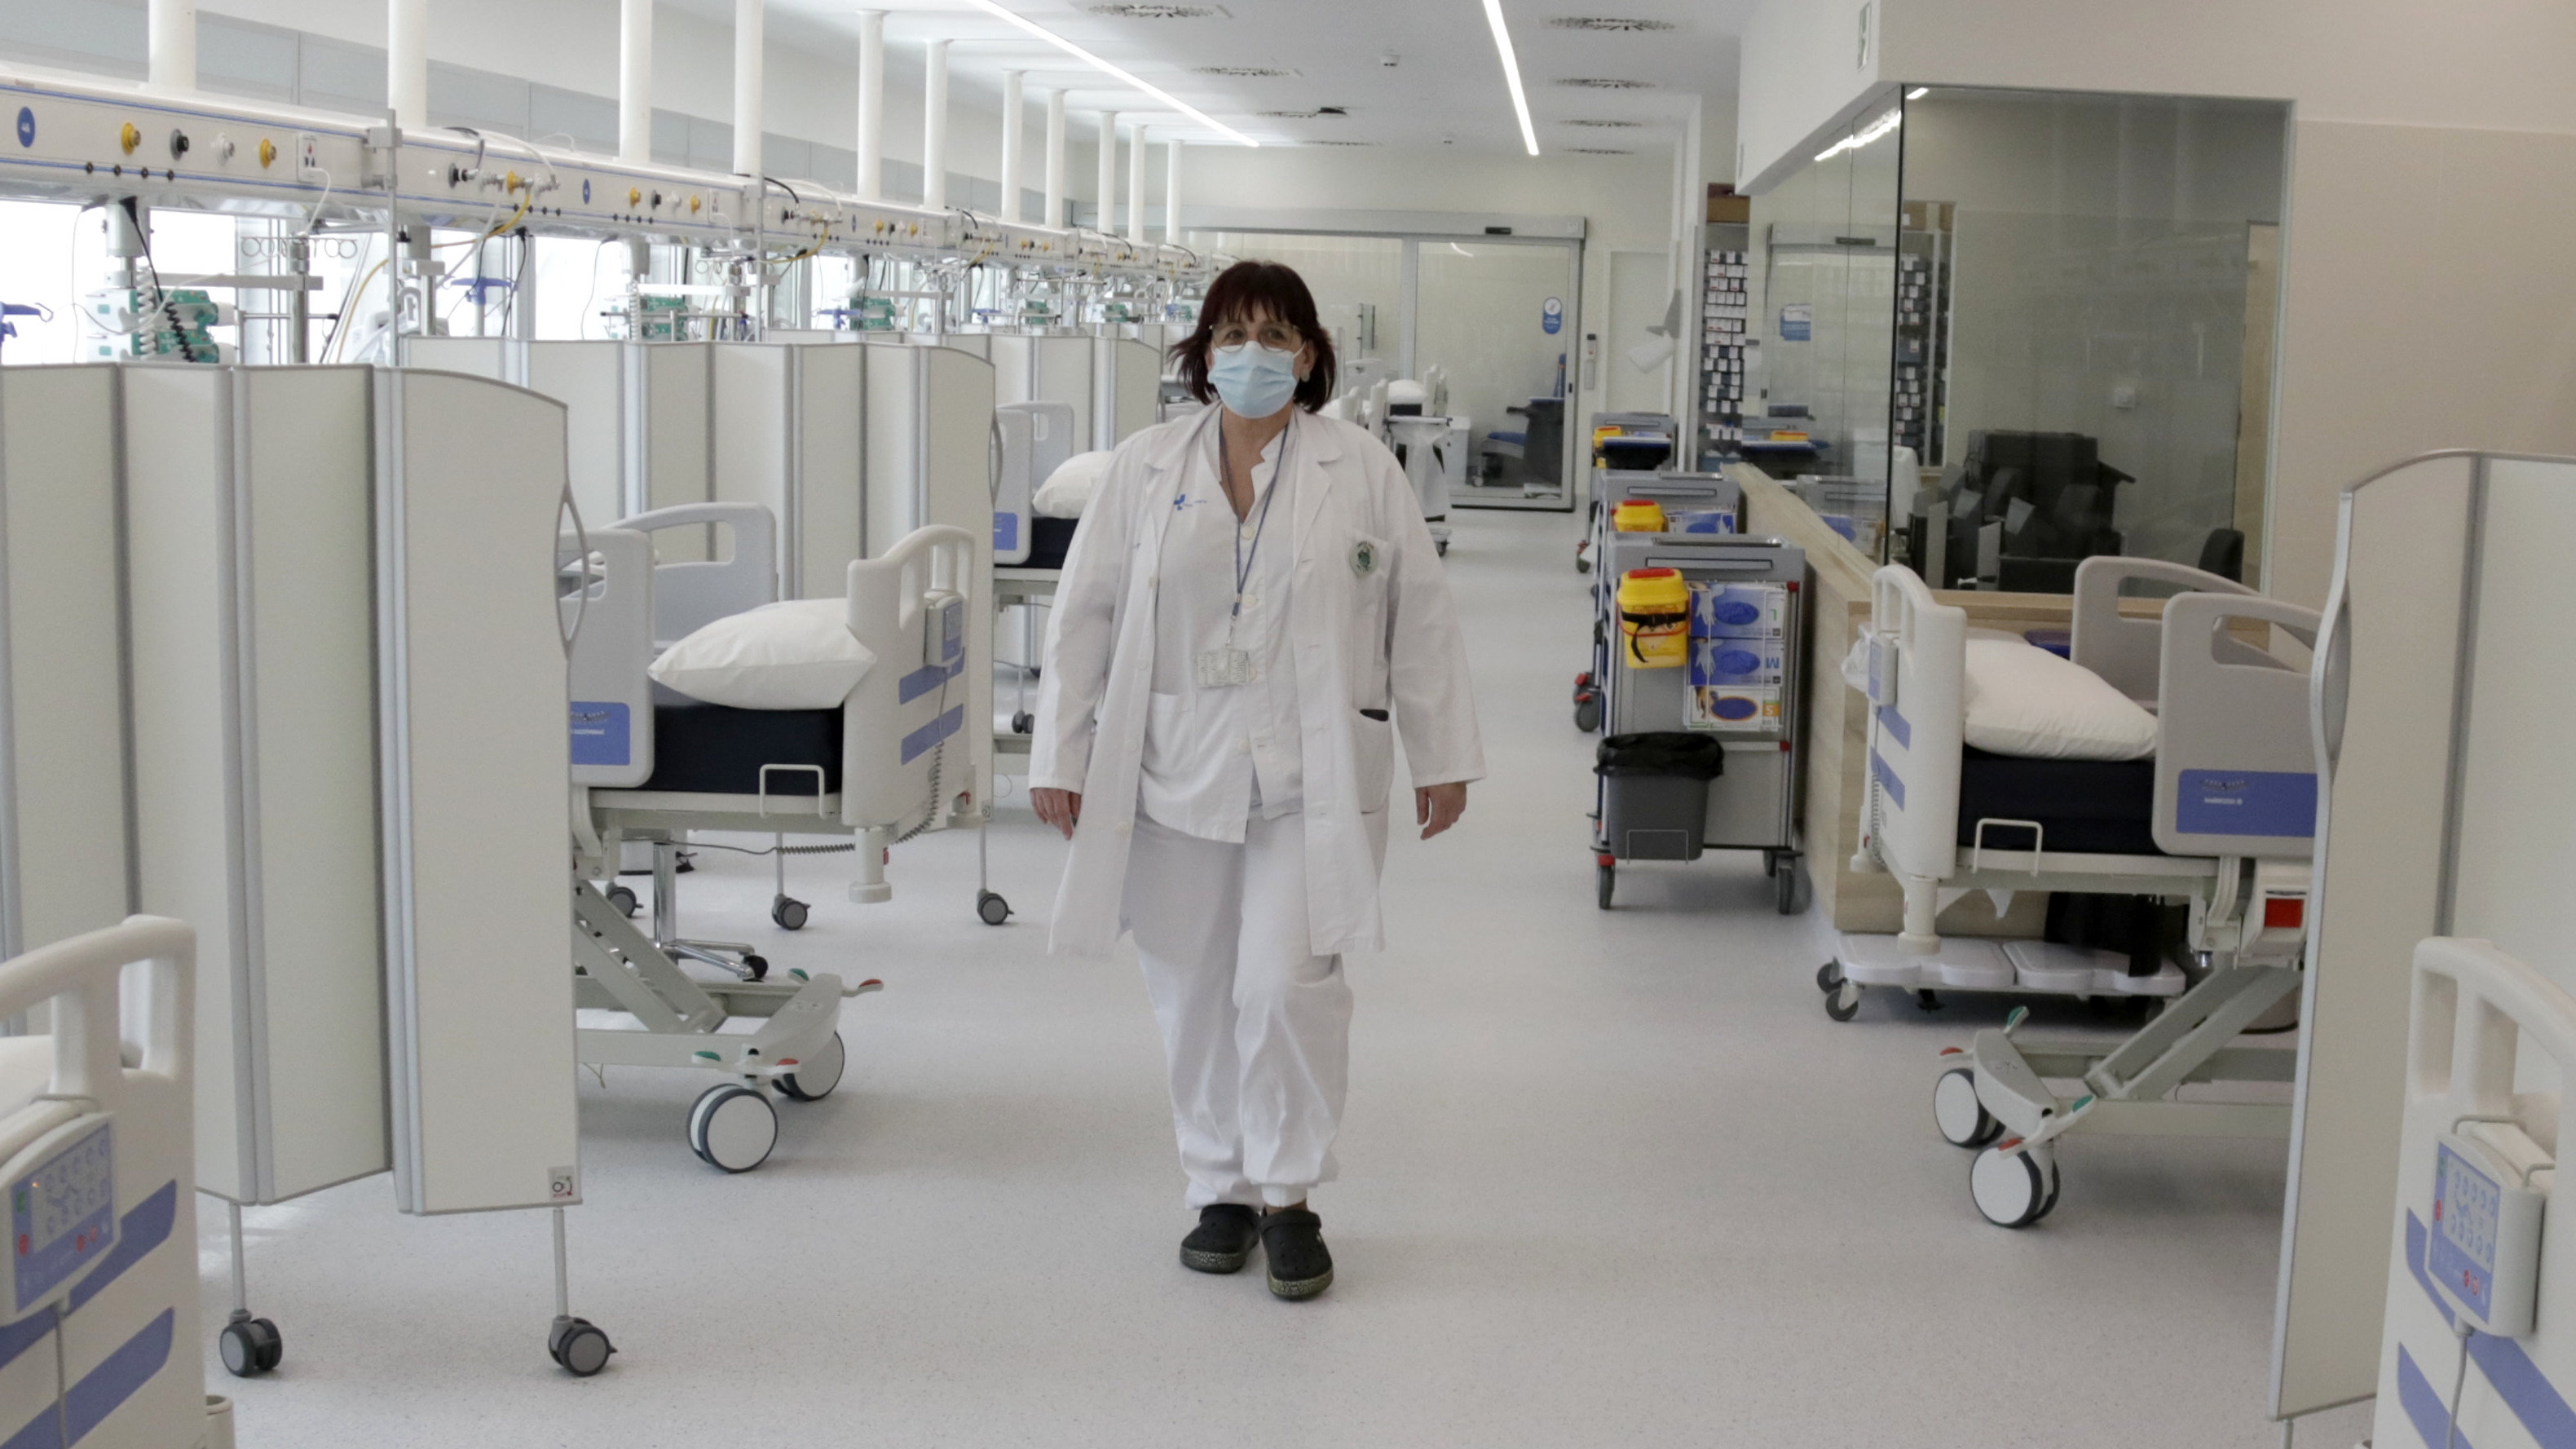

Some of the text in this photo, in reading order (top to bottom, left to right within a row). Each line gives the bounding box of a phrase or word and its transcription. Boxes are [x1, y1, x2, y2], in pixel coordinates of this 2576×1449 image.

[1769, 608, 1777, 621] L
[1766, 657, 1780, 669] M
[1766, 705, 1774, 716] S
